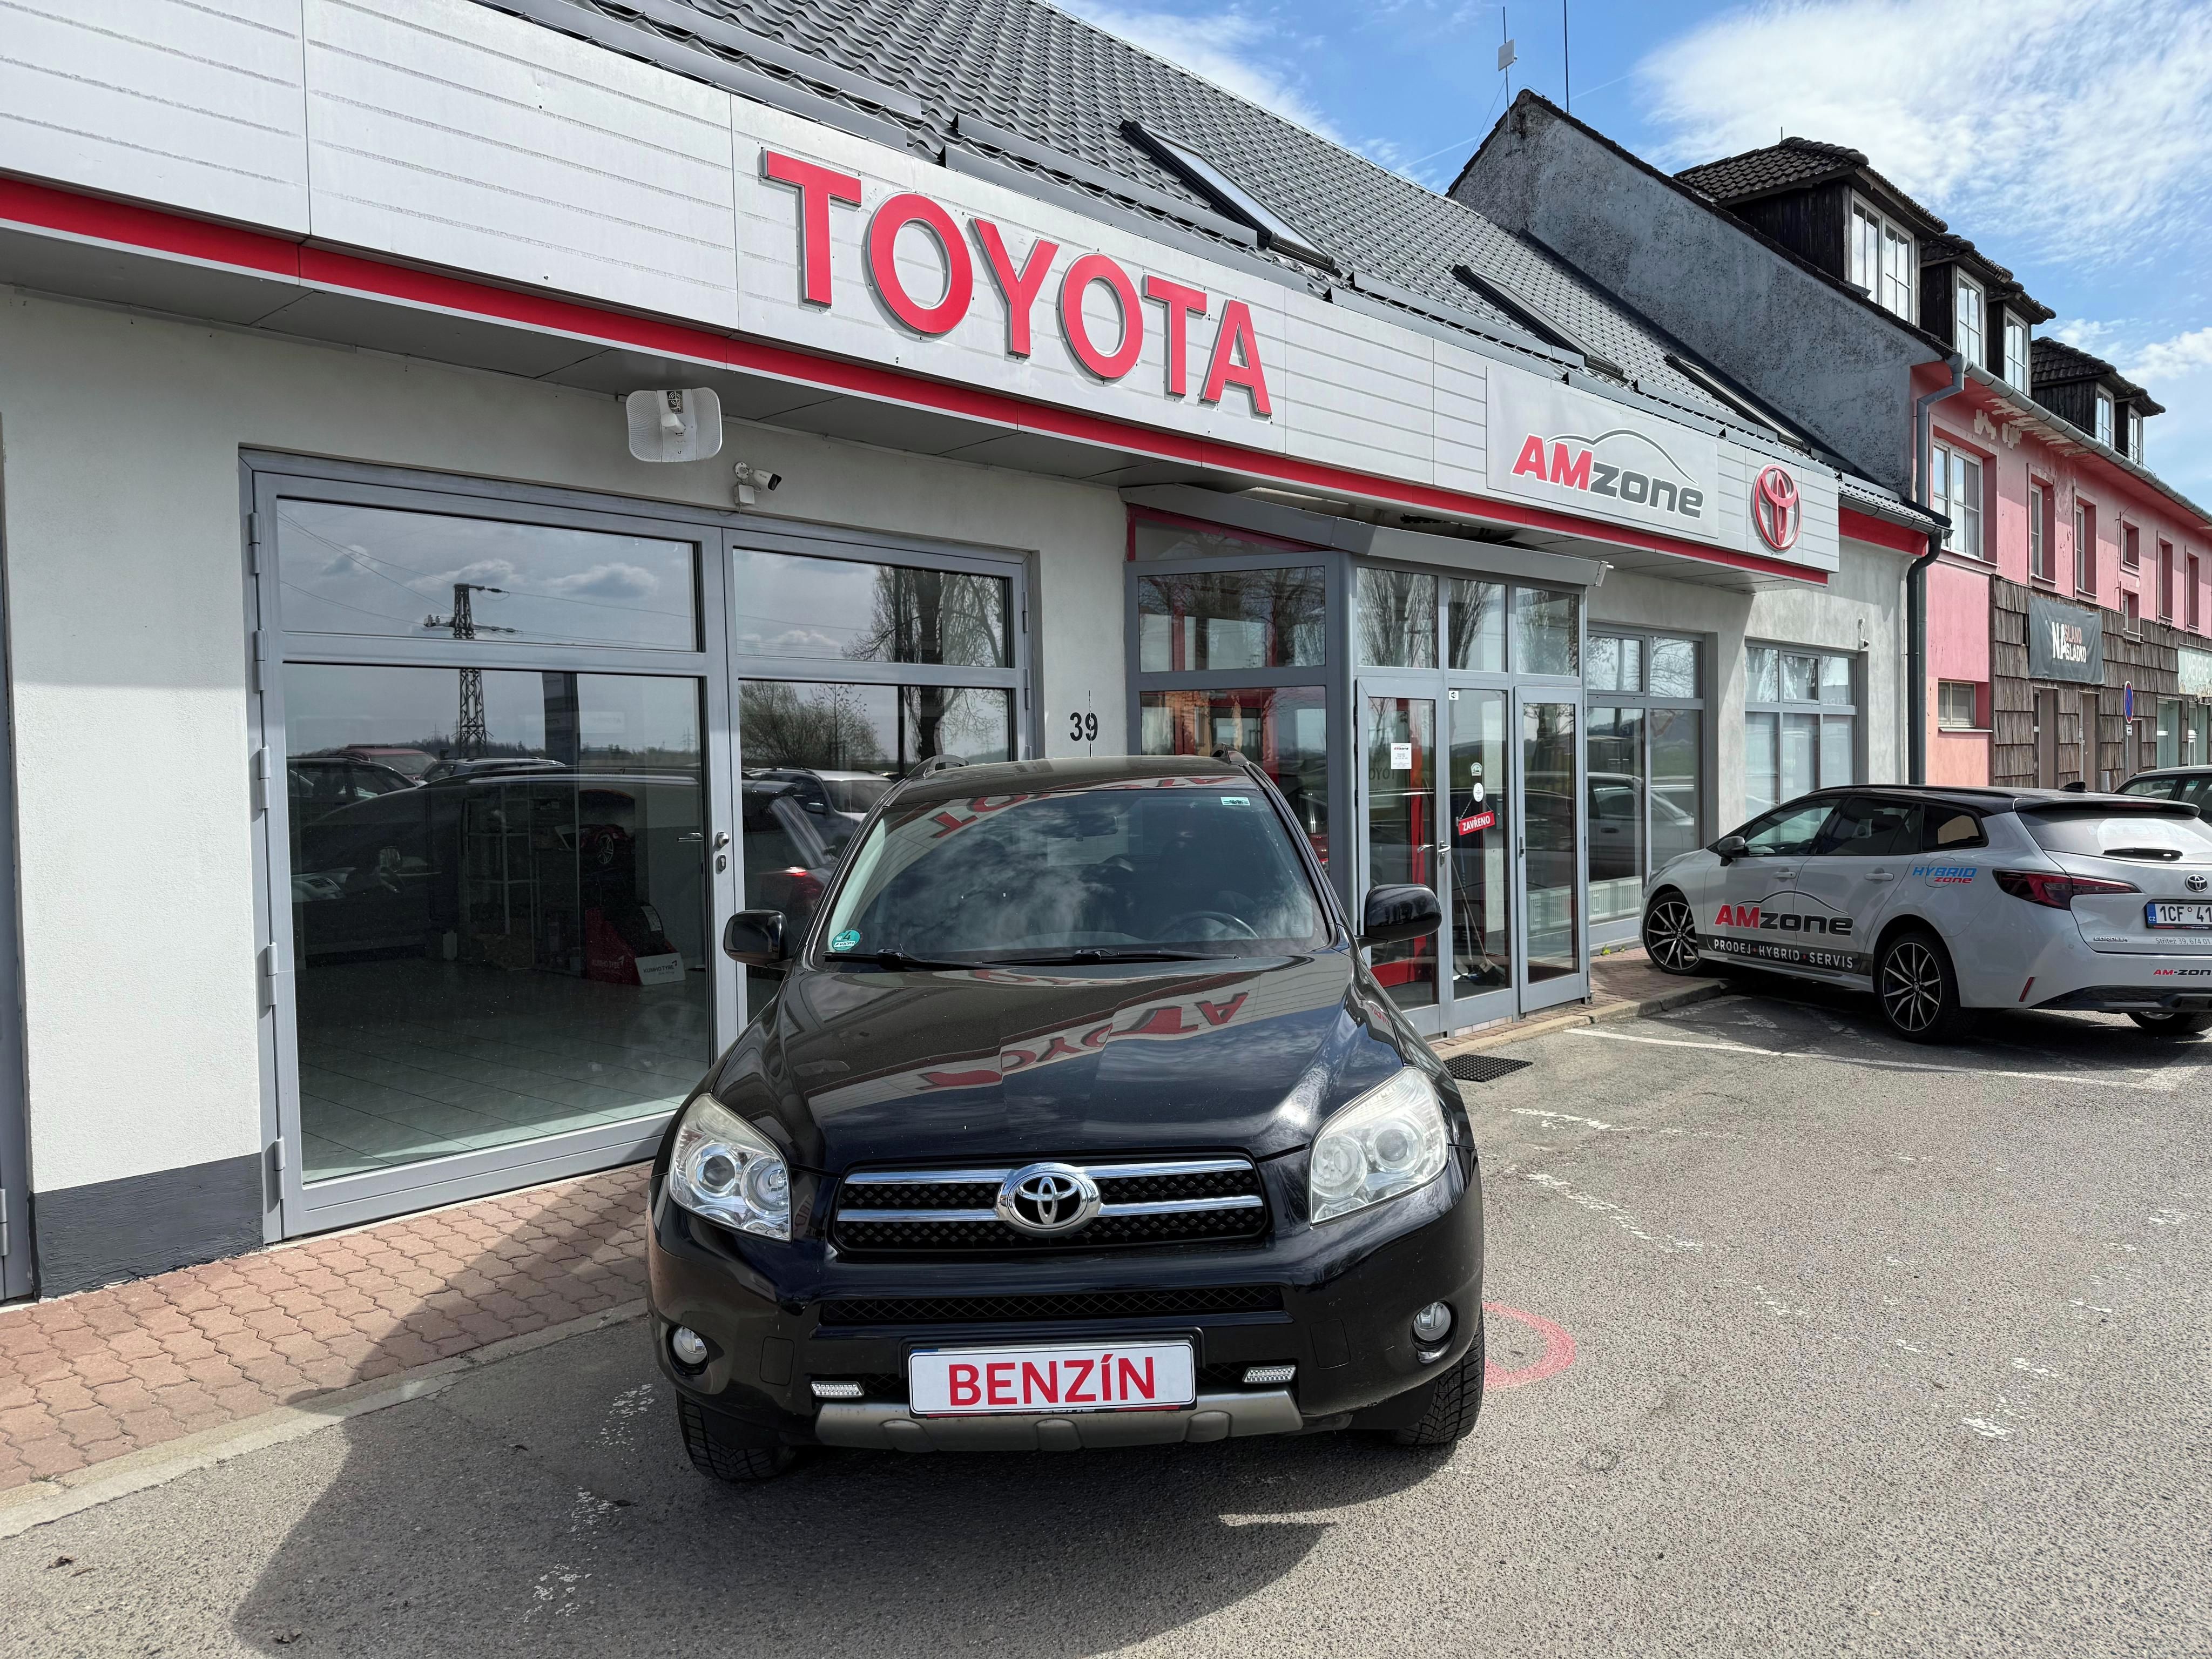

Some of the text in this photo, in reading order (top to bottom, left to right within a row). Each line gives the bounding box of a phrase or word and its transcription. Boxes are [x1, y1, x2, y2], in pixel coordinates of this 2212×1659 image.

[764, 149, 1272, 416] TOYOTA
[1510, 434, 1704, 519] AMzone
[2052, 622, 2082, 659] NA SLANO
[2066, 643, 2087, 663] SLADKO
[1070, 712, 1098, 741] 39
[1462, 815, 1491, 832] ZAVŘENO
[1912, 867, 1977, 878] HYBRID
[1714, 904, 1854, 936] AMzone
[2160, 906, 2184, 922] 1CF
[843, 931, 851, 940] 4
[1714, 939, 1853, 968] PRODEJ HYBRID SERVIS
[948, 1353, 1156, 1406] BENZÍN
